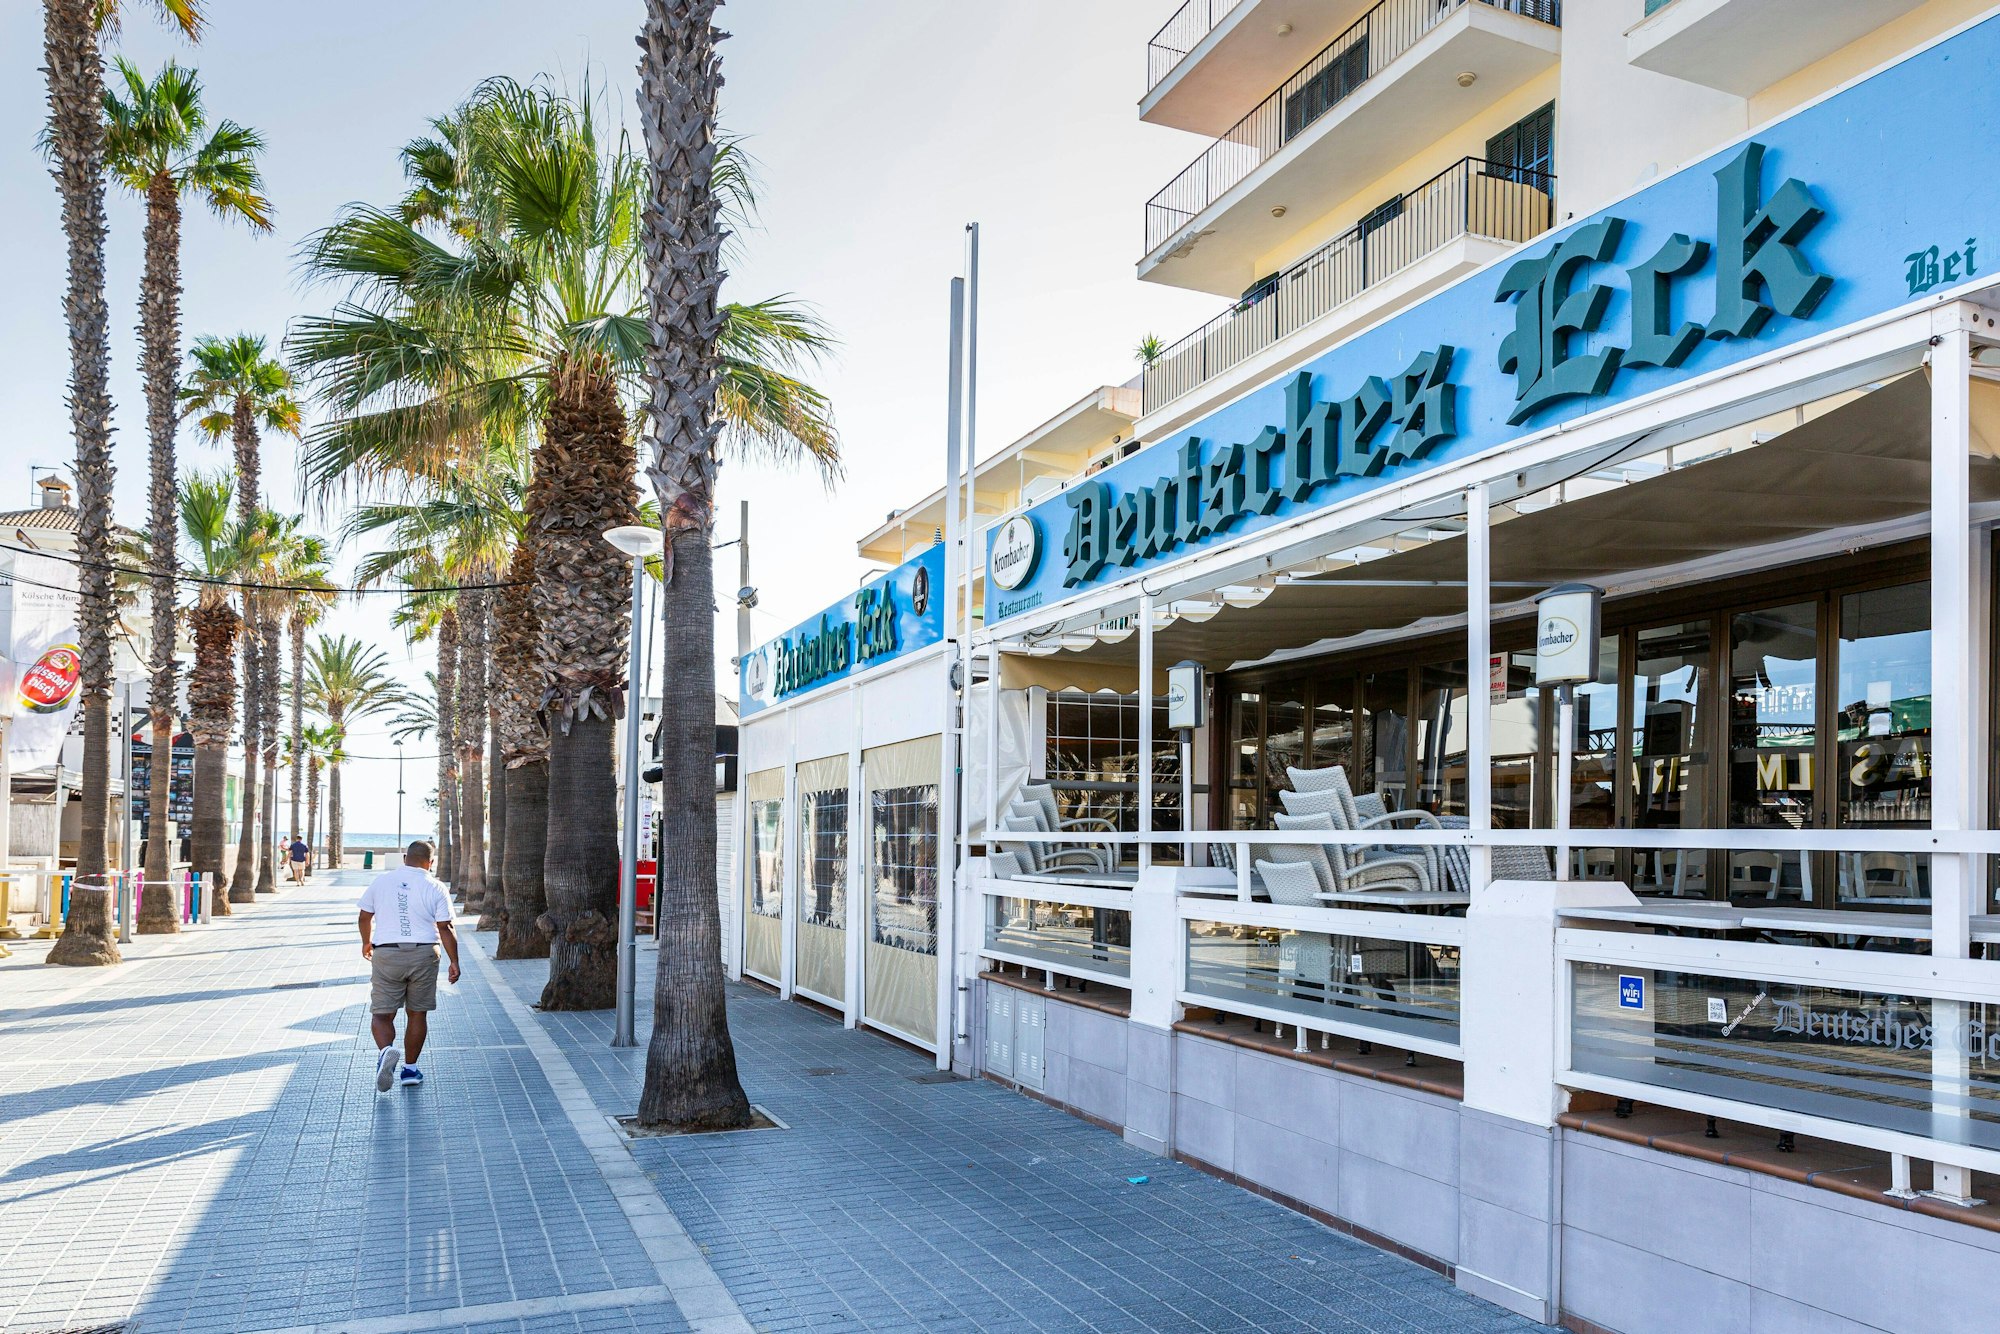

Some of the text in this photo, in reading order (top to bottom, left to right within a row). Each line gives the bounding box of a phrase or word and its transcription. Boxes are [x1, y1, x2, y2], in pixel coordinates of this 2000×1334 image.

[1904, 237, 1978, 298] Bei
[1063, 141, 1835, 589] Deutsches Eck
[994, 541, 1030, 574] Krombacher
[21, 592, 80, 602] Kölsche Mom
[998, 591, 1043, 619] Restaurante
[855, 580, 898, 663] Eck
[1490, 681, 1506, 690] ARMA
[398, 892, 412, 937] BEACH HOUSE
[1771, 997, 2000, 1061] Deutsches Ec
